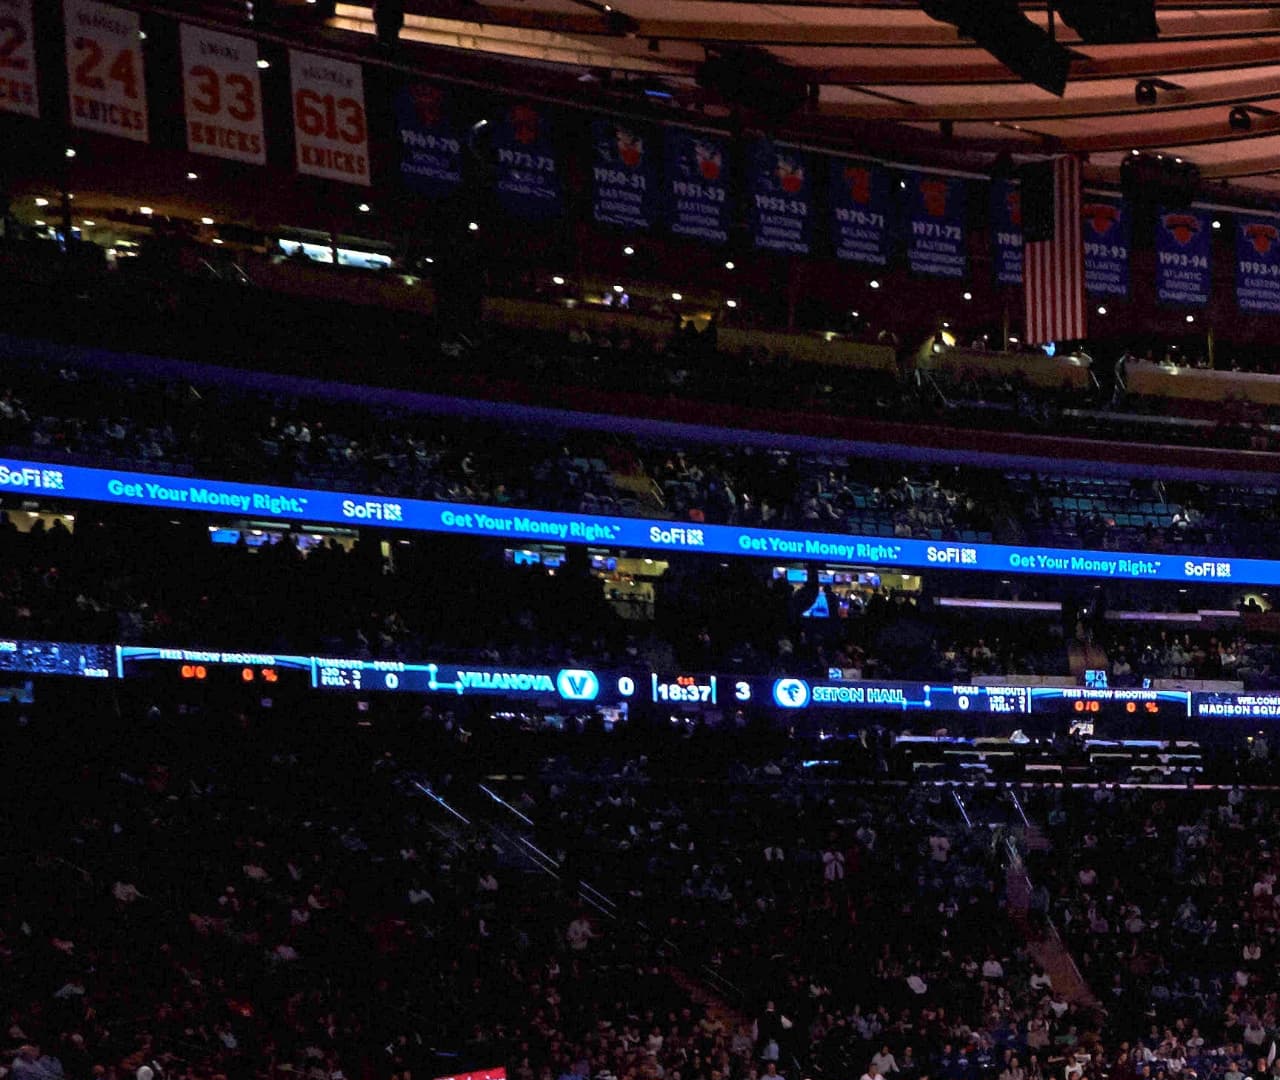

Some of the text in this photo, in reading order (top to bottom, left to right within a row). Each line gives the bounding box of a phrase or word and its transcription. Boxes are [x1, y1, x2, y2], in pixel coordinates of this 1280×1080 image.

[73, 36, 138, 99] 24
[190, 65, 255, 121] 33
[73, 95, 144, 130] KNICKS
[296, 90, 367, 146] 613
[187, 121, 261, 155] KNICKS
[301, 146, 366, 175] KNICKS
[1159, 251, 1208, 269] 1993-94
[0, 468, 41, 488] SoFi
[107, 479, 143, 499] Get
[144, 482, 189, 503] Your
[190, 488, 251, 513] Money
[342, 500, 383, 520] SoFi
[441, 510, 472, 528] Get
[473, 513, 512, 531] Your
[514, 519, 568, 541] Money
[649, 526, 686, 545] SoFi
[738, 535, 768, 553] Get
[769, 537, 804, 554] Your
[805, 541, 854, 560] Money
[926, 547, 960, 563] SoFi
[1009, 554, 1035, 569] Get
[1036, 554, 1069, 570] Your
[1070, 557, 1116, 574] Money
[1183, 561, 1216, 577] SoFi
[221, 653, 275, 665] SHOOTING
[457, 670, 906, 703] VILLANOVA 0 3 SETON HALL
[657, 684, 711, 702] 18:37
[1082, 690, 1113, 699] THROW
[1114, 691, 1157, 699] SHOOTING
[1199, 704, 1250, 714] MADISON
